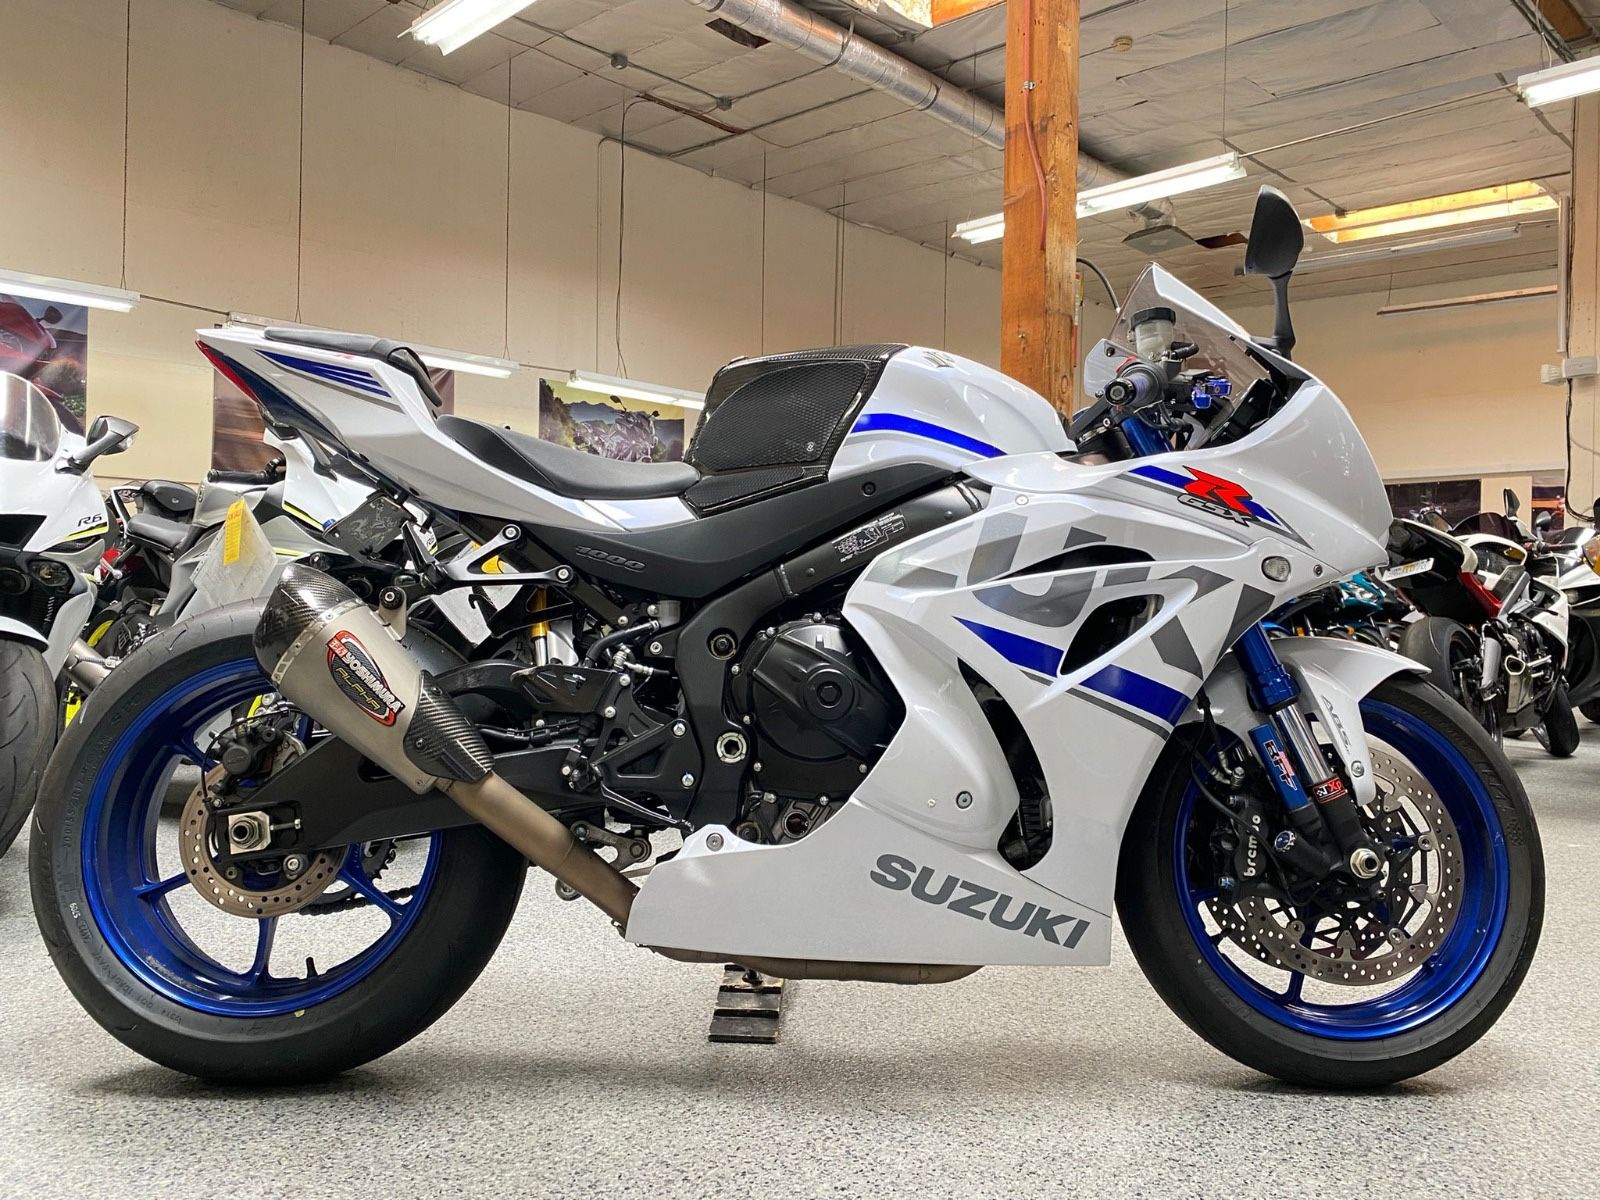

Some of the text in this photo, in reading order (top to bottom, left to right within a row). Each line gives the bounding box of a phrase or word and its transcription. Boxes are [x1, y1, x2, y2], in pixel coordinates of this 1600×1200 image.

[1177, 493, 1250, 528] GSX
[1182, 465, 1254, 517] R
[78, 513, 102, 527] R6
[575, 545, 648, 573] 1000
[335, 667, 381, 710] ALPHA
[342, 651, 401, 713] YOSHIMURA
[870, 853, 1091, 949] SUZUKI
